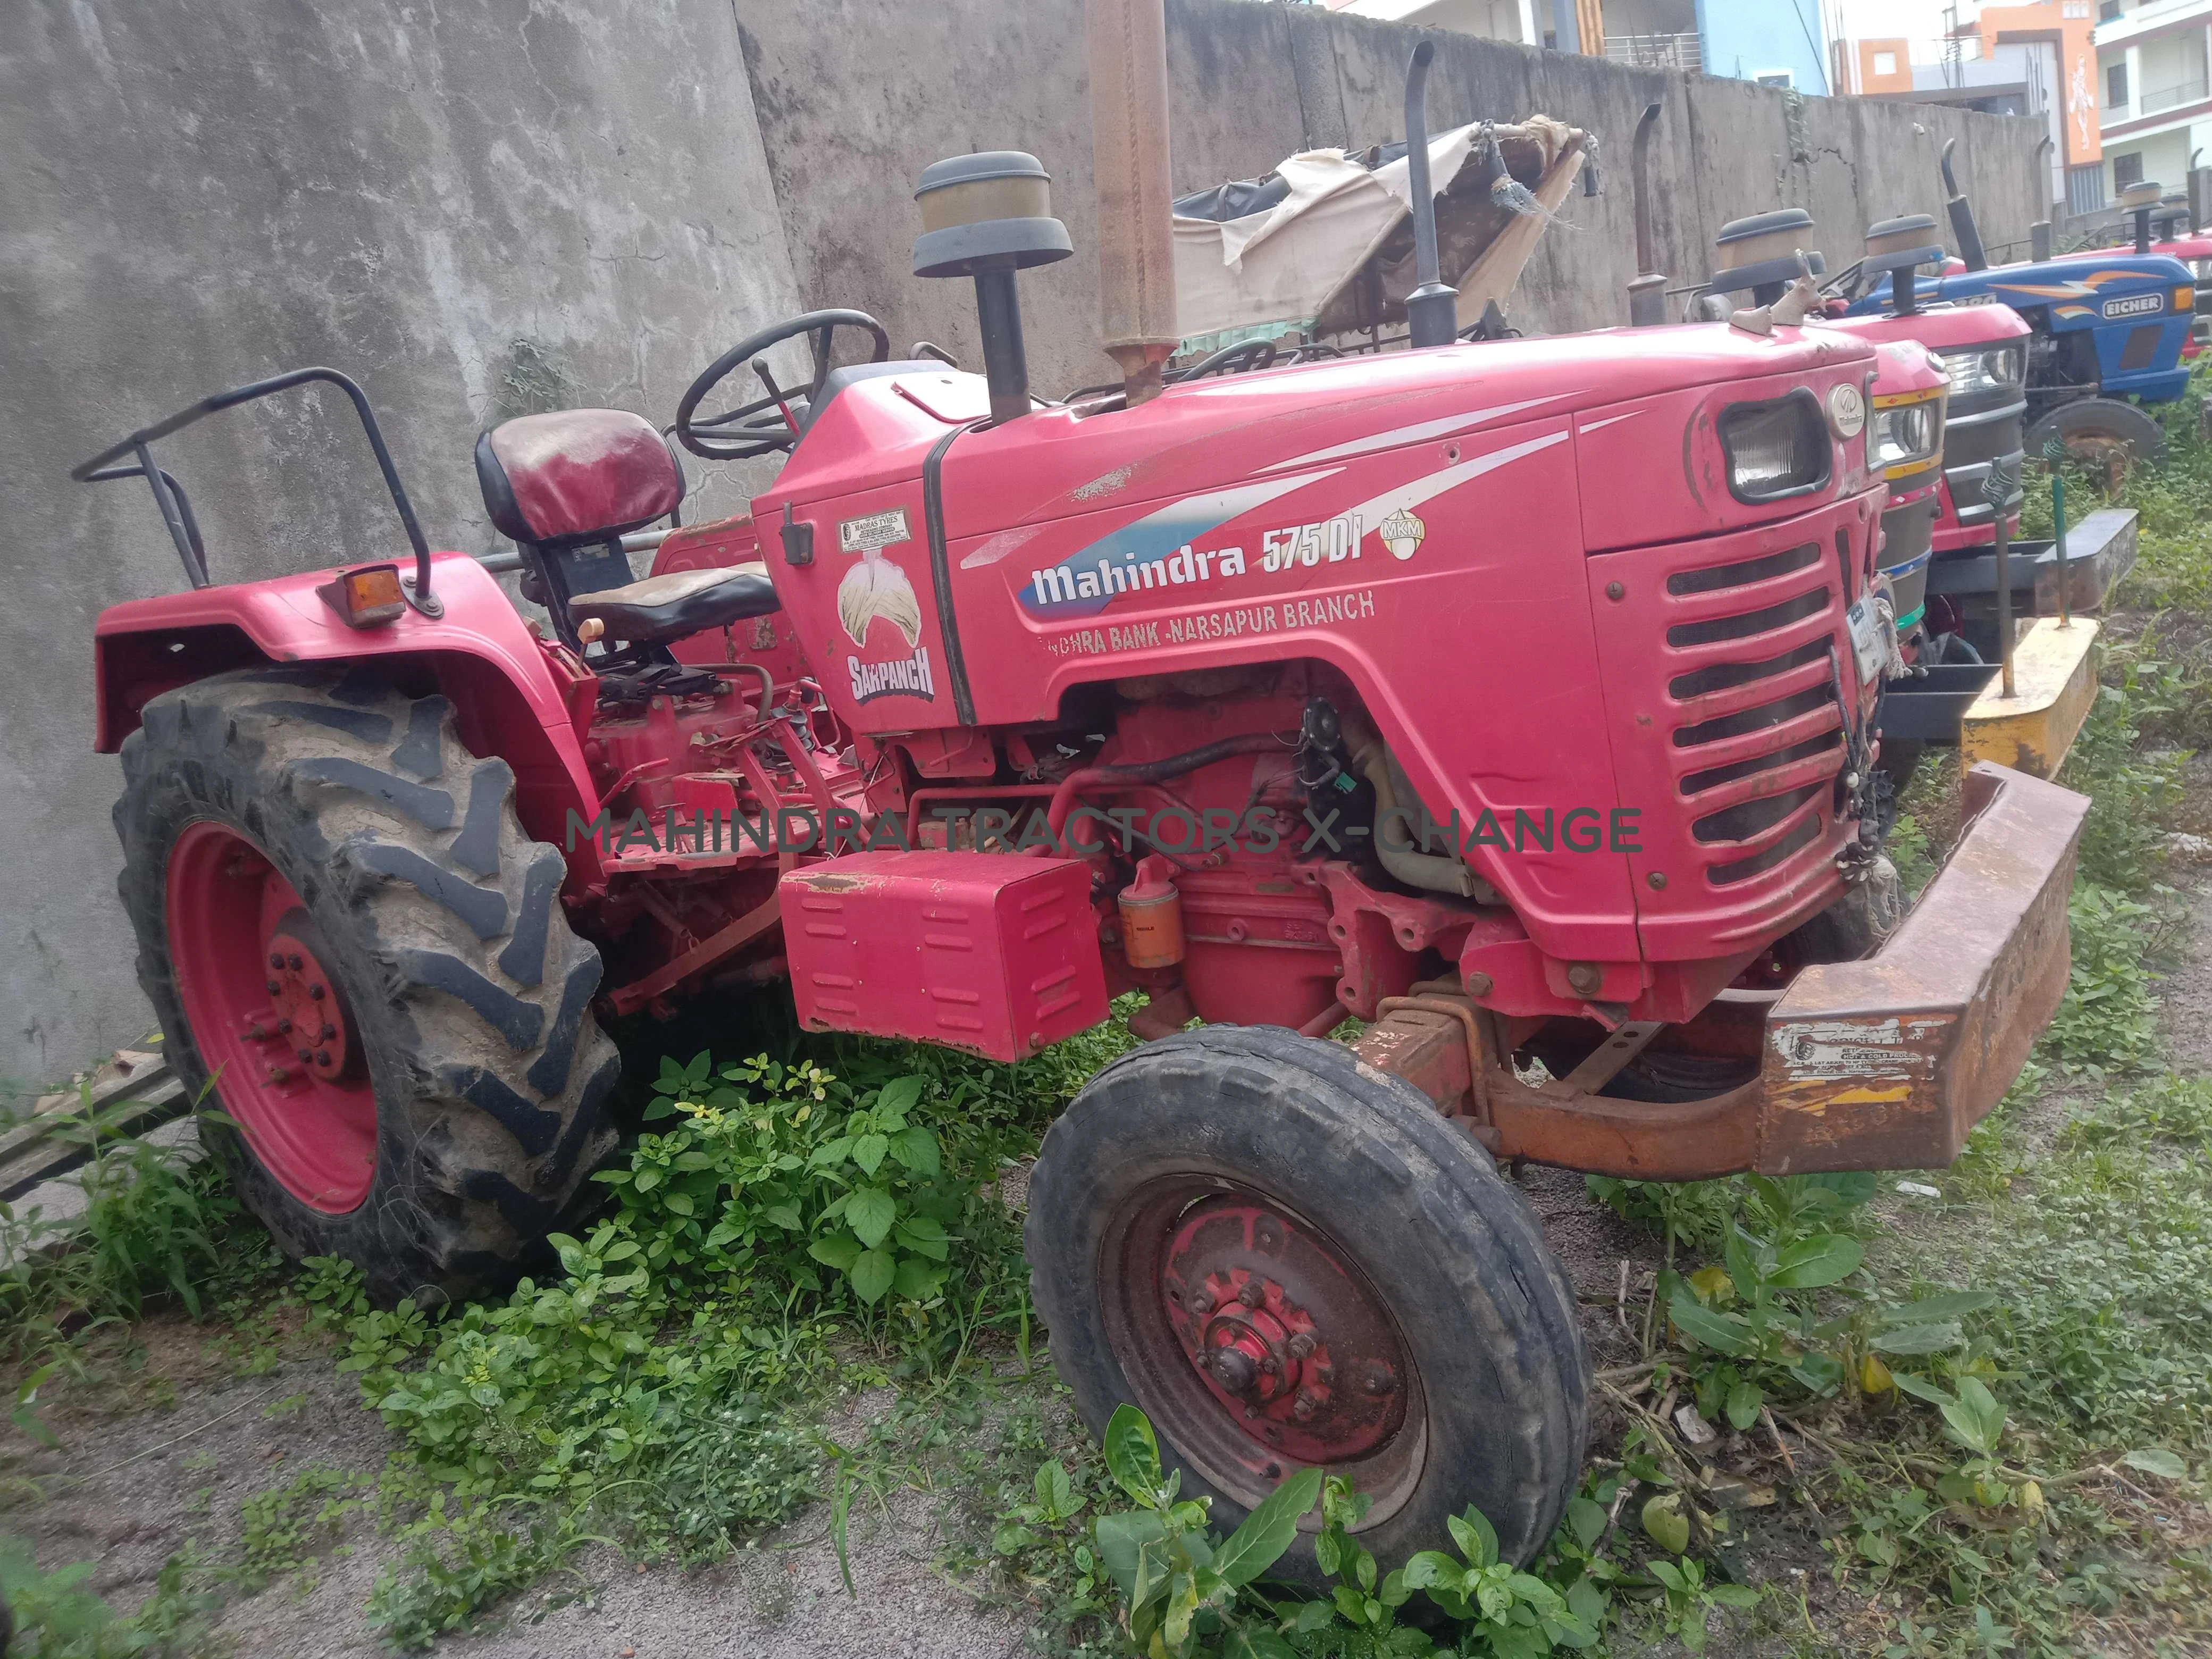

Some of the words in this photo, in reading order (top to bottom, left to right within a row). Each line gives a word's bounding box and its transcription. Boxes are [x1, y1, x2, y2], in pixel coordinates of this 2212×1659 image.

[2106, 297, 2159, 315] EICHER
[854, 520, 878, 531] MADRAS
[878, 515, 898, 525] TYRES
[1382, 519, 1422, 539] MKM
[1031, 543, 1246, 605] Mahindra
[1262, 522, 1322, 574] 575
[1329, 514, 1363, 563] DI
[1108, 622, 1161, 652] BANK
[1283, 590, 1375, 629] BRANCH
[847, 645, 935, 703] SARPANCH
